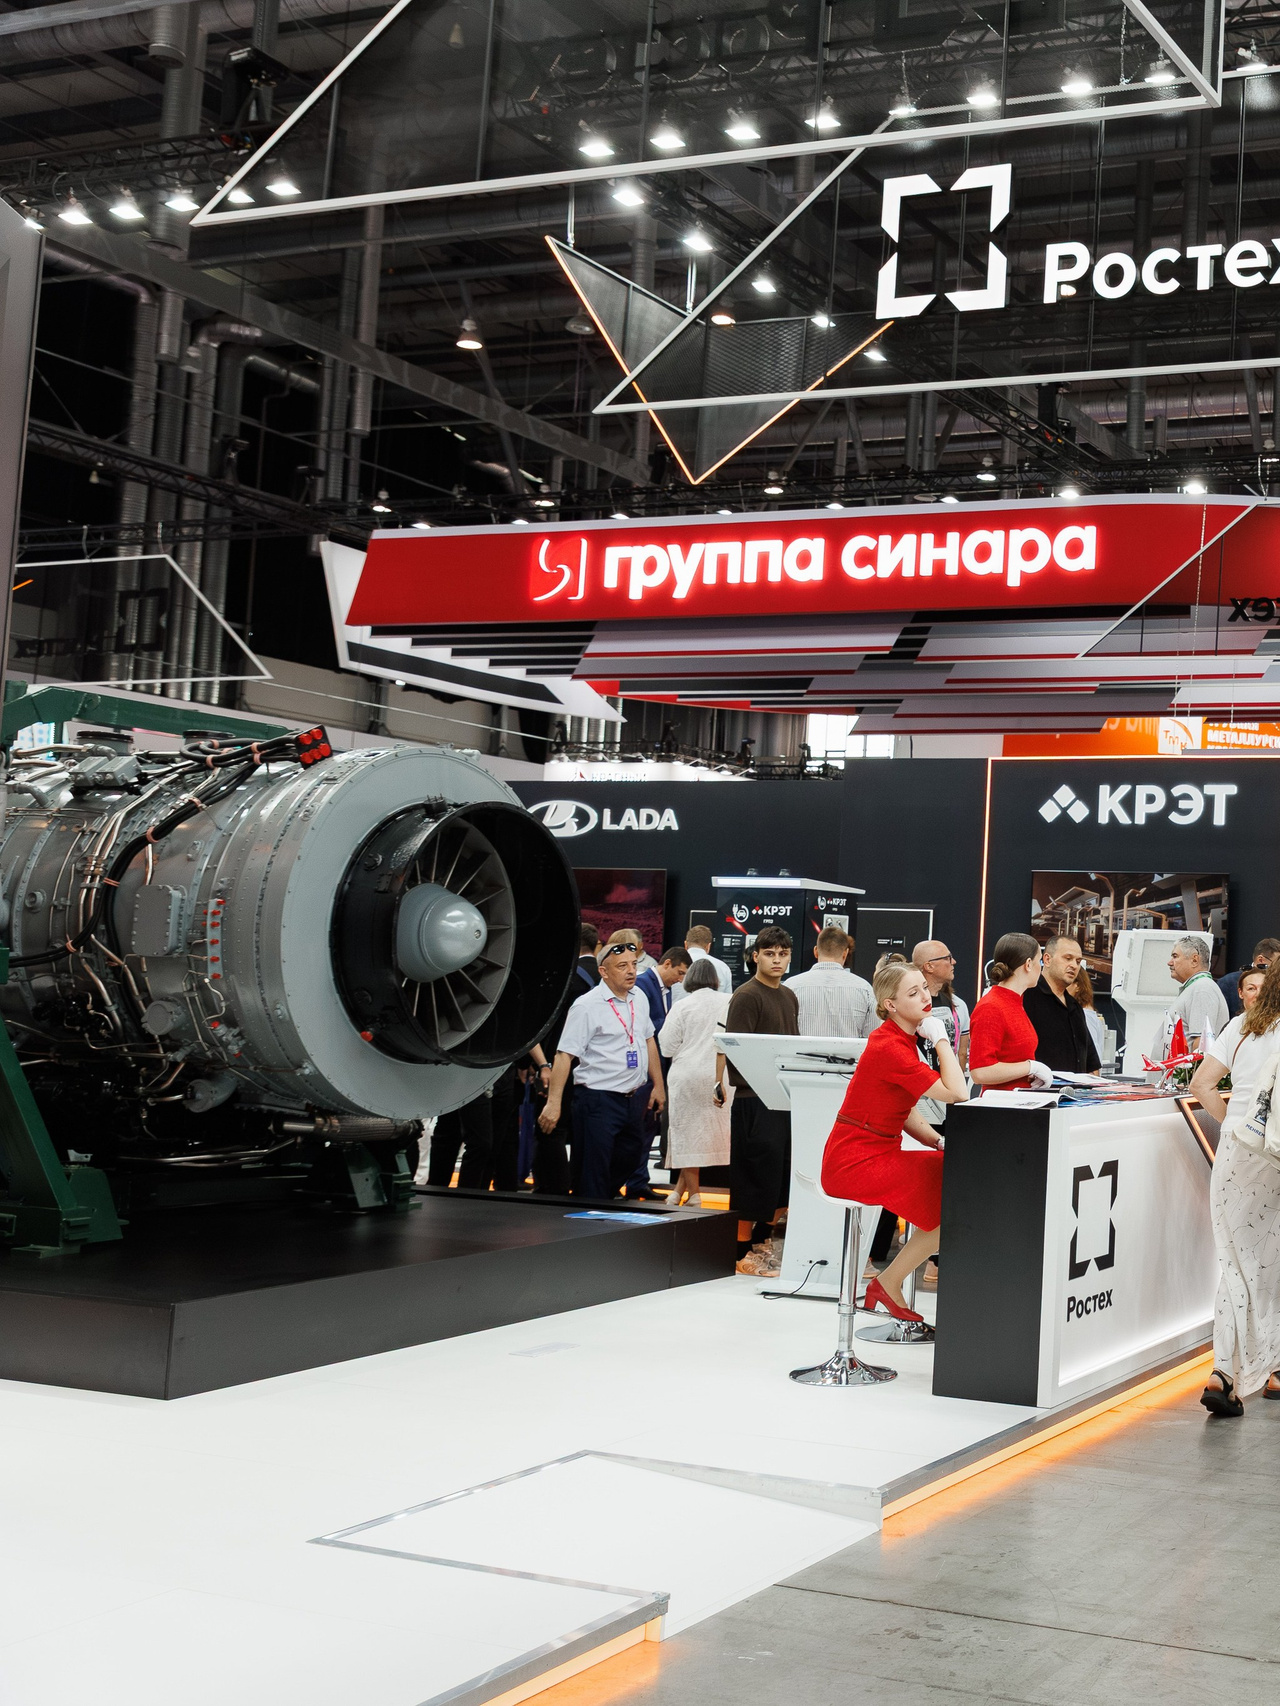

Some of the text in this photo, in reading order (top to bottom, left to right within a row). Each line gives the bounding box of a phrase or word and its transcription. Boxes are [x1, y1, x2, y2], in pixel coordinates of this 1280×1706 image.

[603, 524, 1097, 600] группа синара
[602, 808, 679, 830] LADA
[1097, 784, 1238, 826] КРЭТ
[763, 905, 793, 916] КРЭТ
[1066, 1288, 1113, 1322] Ростех
